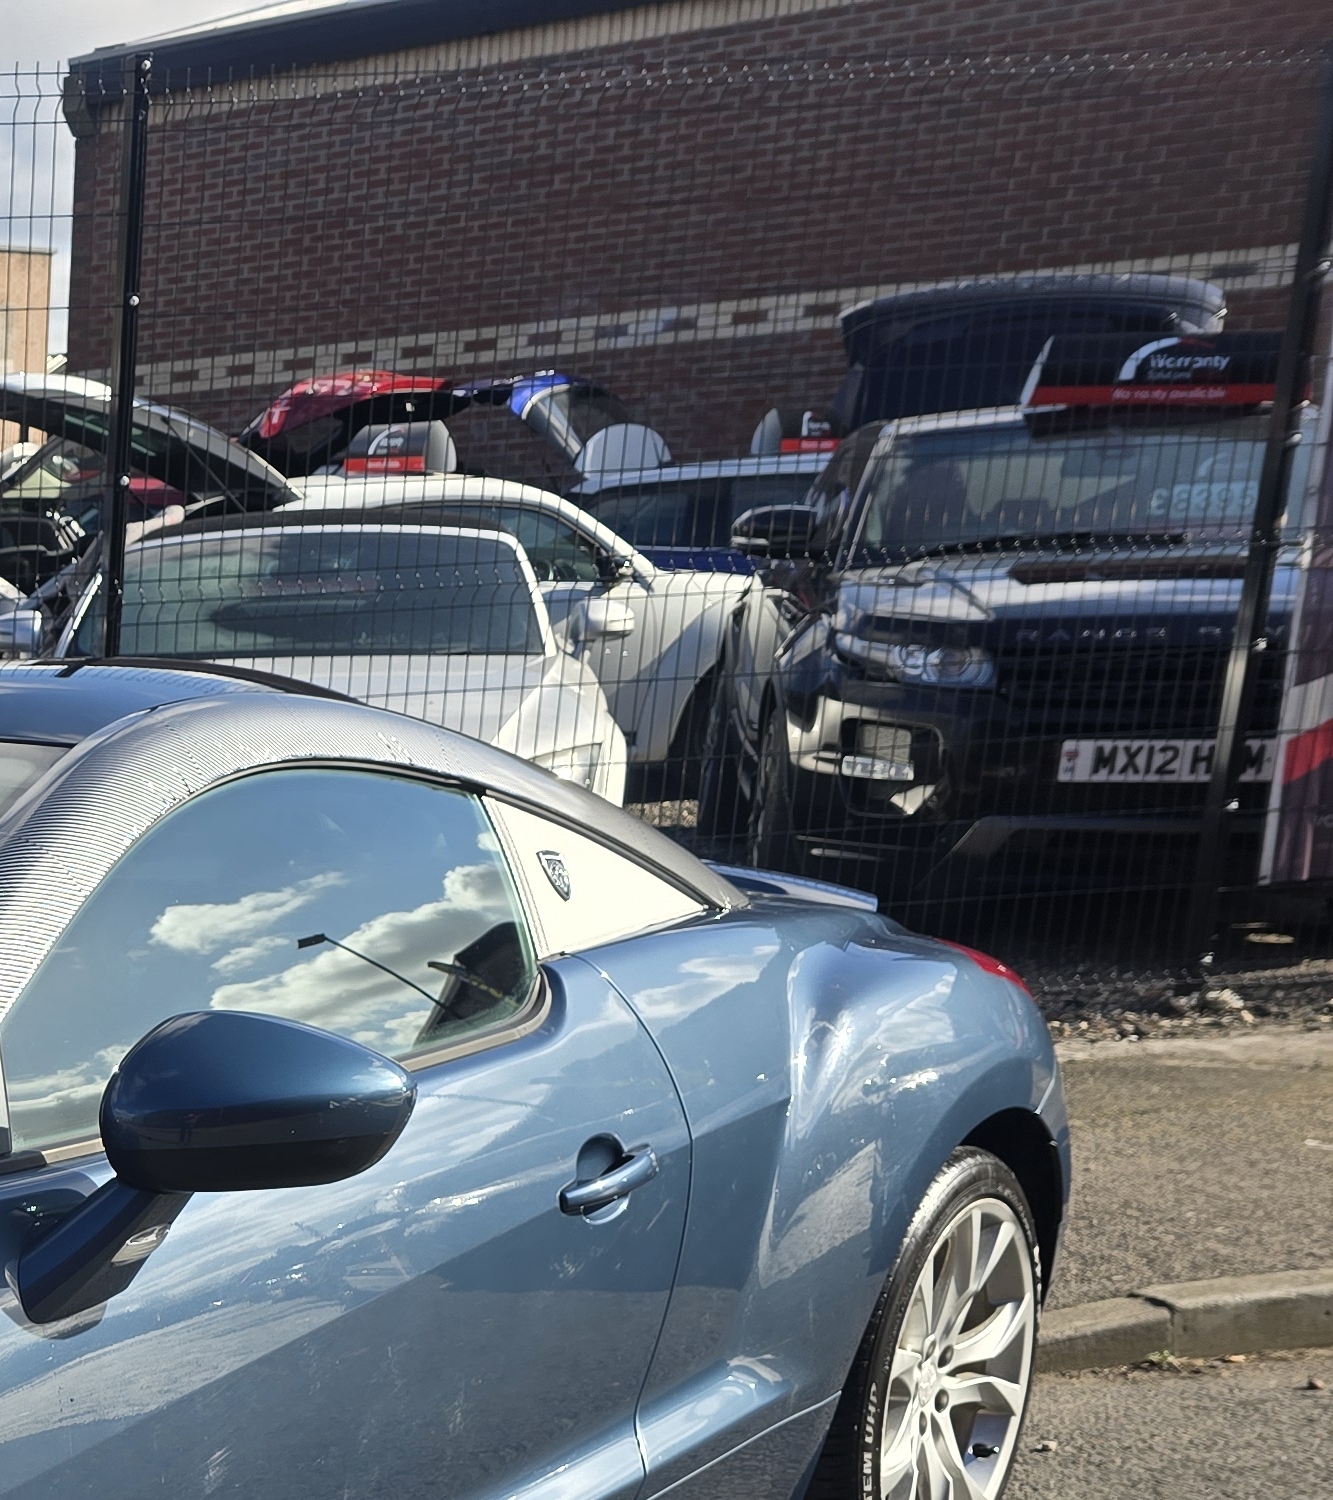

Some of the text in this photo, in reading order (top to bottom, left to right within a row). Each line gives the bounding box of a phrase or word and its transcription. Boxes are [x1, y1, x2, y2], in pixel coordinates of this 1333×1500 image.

[1149, 354, 1231, 371] Warranty
[1092, 743, 1267, 775] MX12 HM
